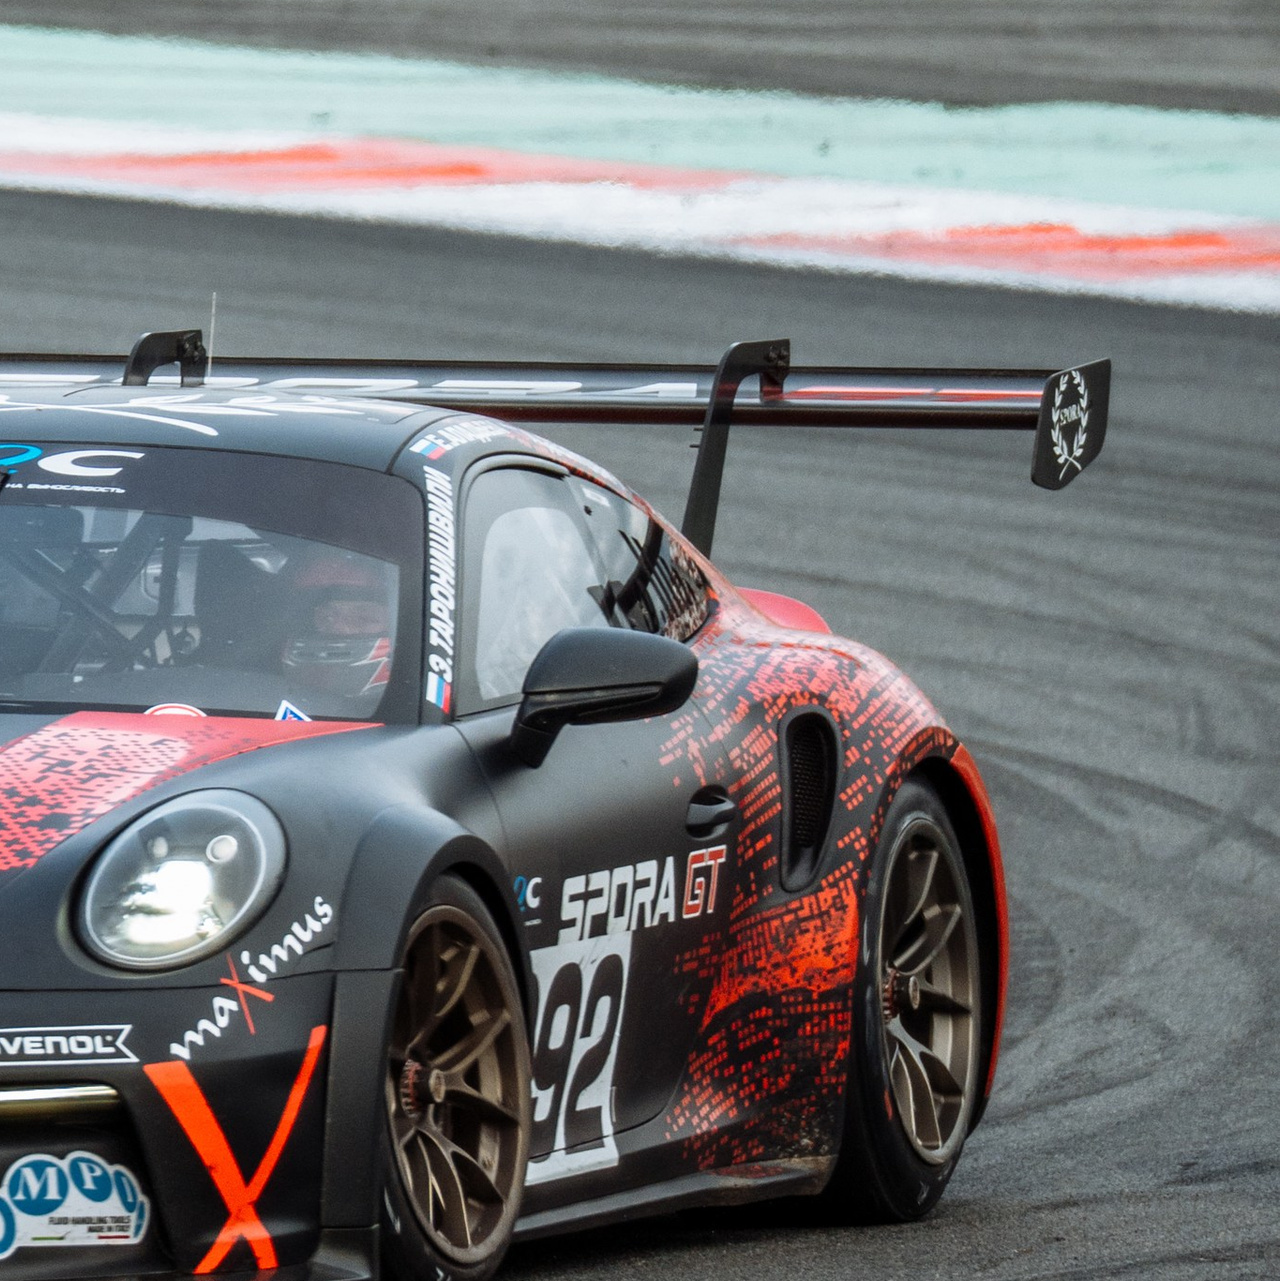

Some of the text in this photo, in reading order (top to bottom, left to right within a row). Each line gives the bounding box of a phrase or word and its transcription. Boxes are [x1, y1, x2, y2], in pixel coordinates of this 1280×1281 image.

[169, 895, 334, 1061] maXimus
[558, 844, 728, 946] SPORA GT
[531, 952, 625, 1164] 92
